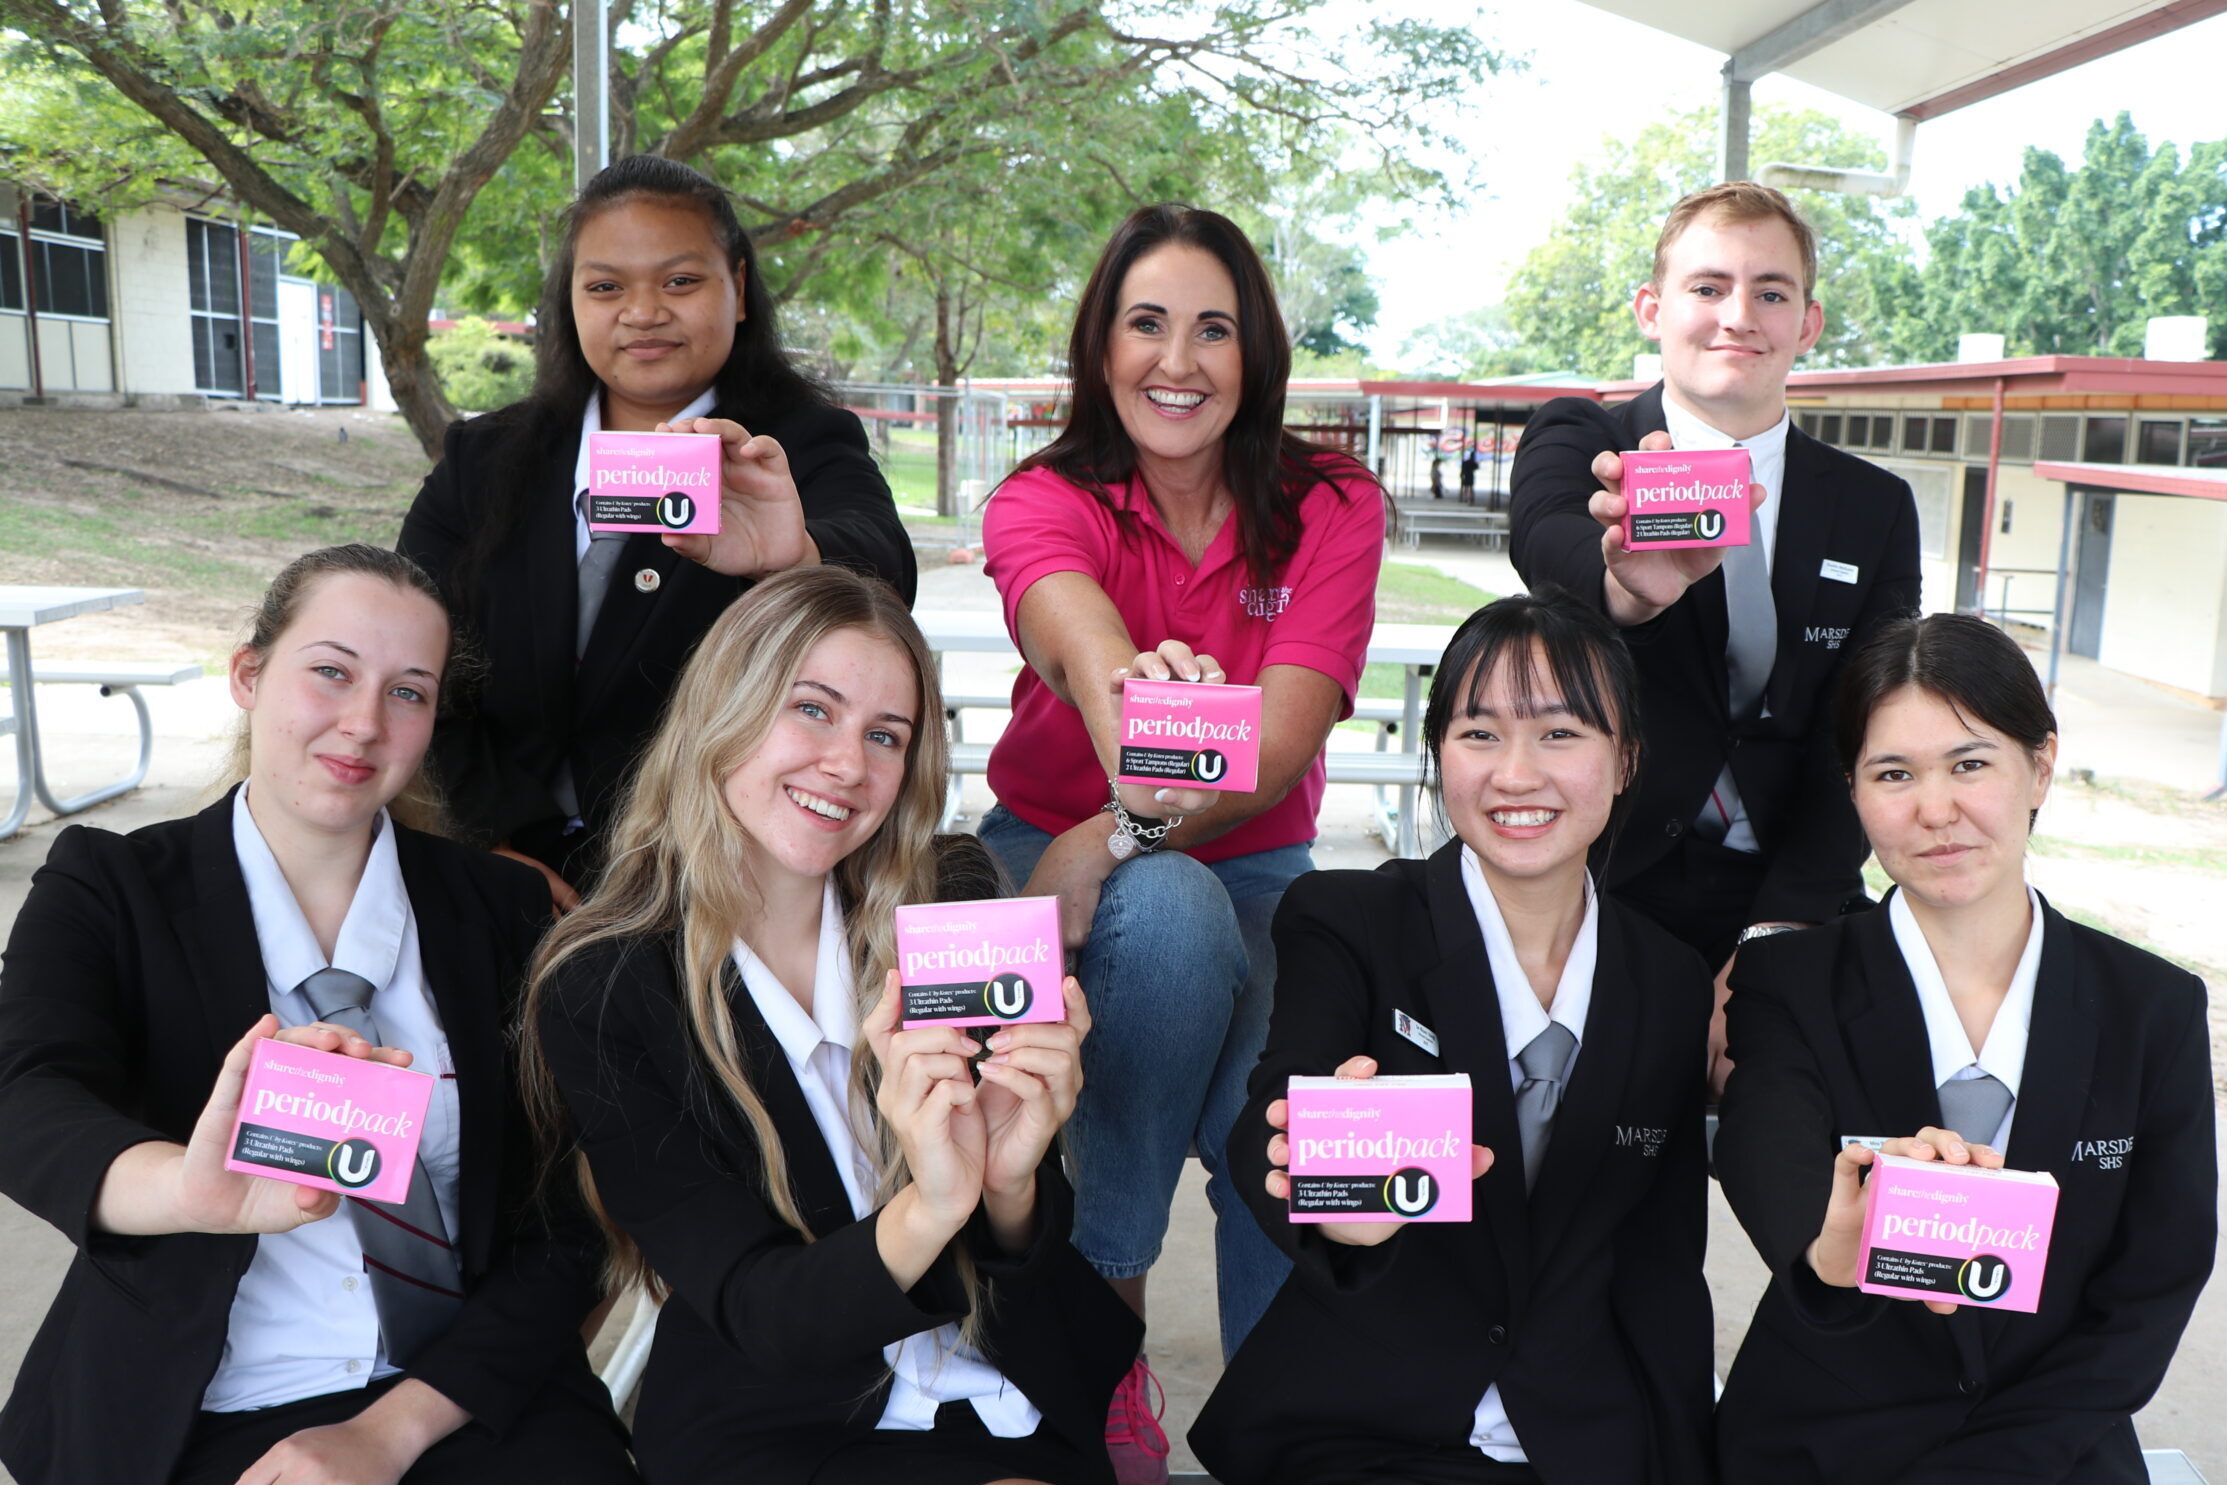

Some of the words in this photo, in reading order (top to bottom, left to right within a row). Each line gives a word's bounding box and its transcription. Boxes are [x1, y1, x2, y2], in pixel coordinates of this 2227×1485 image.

[596, 465, 711, 491] periodpack
[1635, 479, 1744, 508] periodpack
[664, 498, 689, 526] U
[1700, 513, 1721, 538] U
[1128, 714, 1252, 744] periodpack
[1198, 753, 1223, 780] U
[906, 937, 1049, 977] periodpack
[993, 979, 1025, 1015] U
[253, 1088, 413, 1138] periodpack
[338, 1143, 375, 1183] U
[1298, 1130, 1460, 1166] periodpack
[2099, 1156, 2123, 1169] SHS
[1395, 1175, 1429, 1213] U
[1882, 1213, 2040, 1251] periodpack
[1968, 1260, 2005, 1298] U
